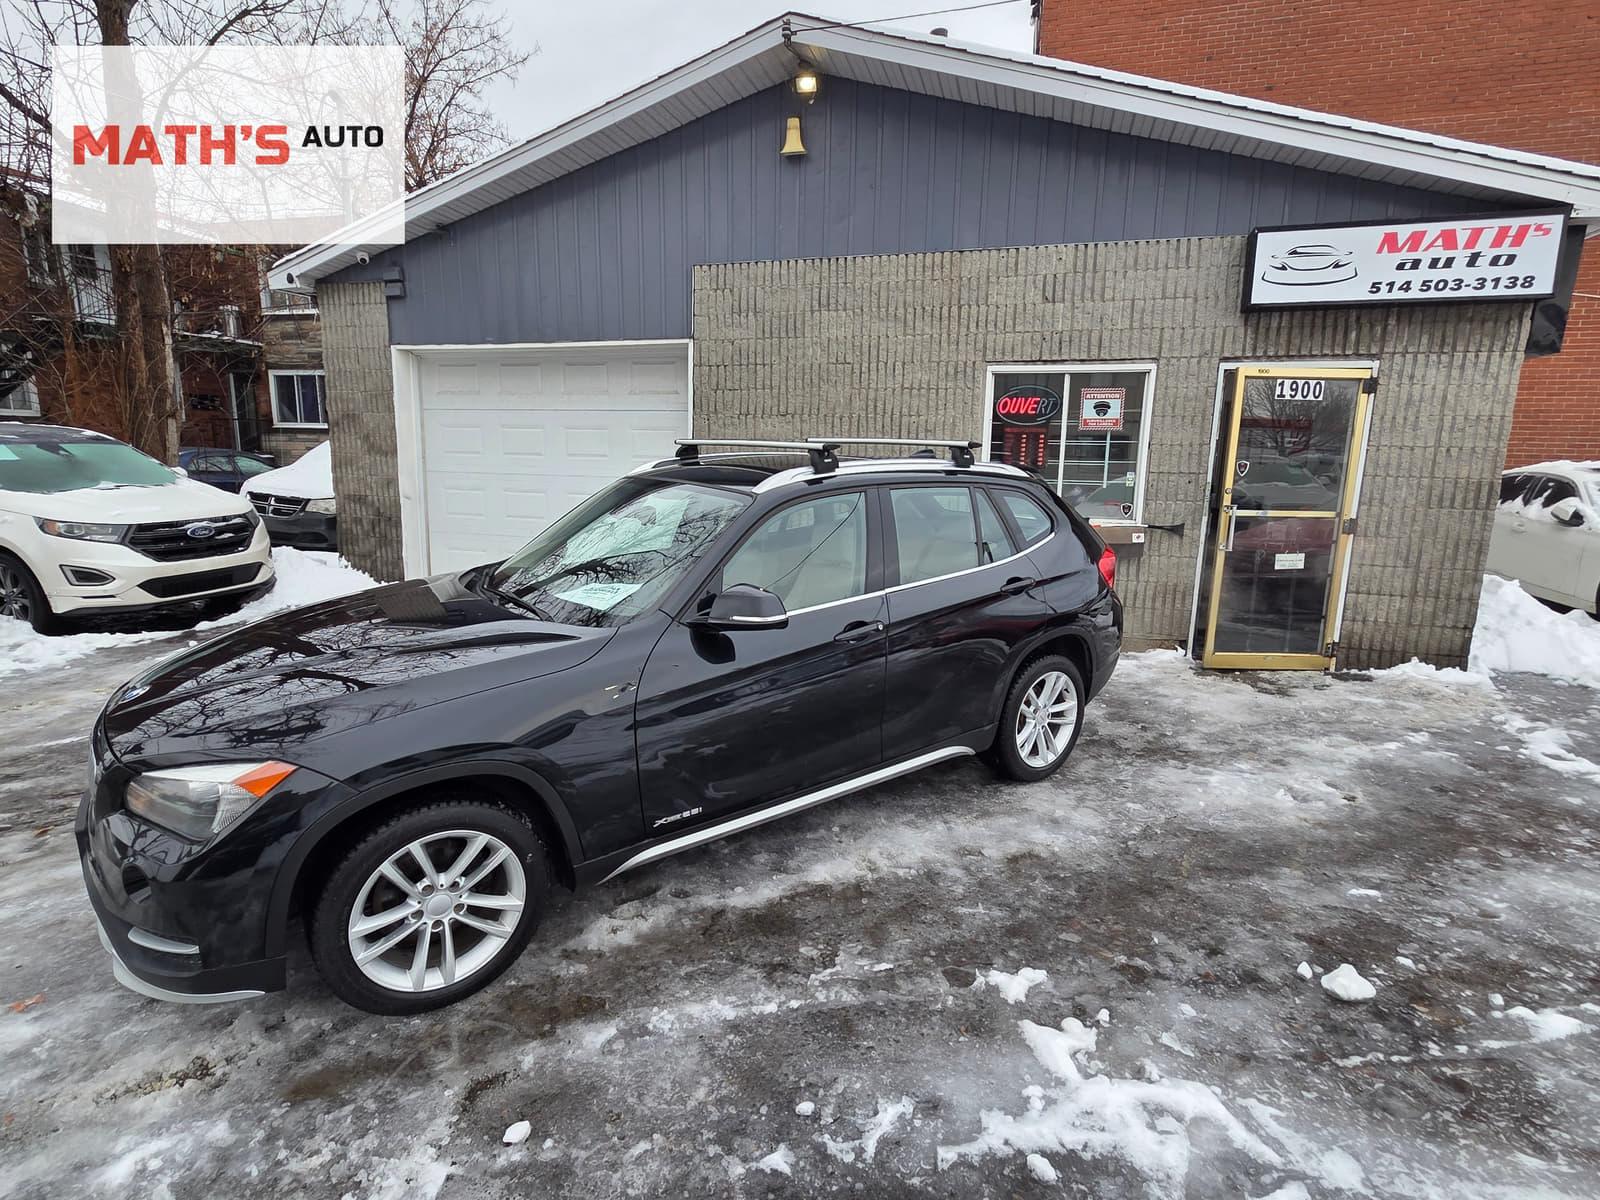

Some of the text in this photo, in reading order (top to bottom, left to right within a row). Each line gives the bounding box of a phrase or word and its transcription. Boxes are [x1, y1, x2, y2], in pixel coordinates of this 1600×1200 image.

[1395, 251, 1518, 271] auto
[1368, 275, 1536, 295] 514 503-3138
[1276, 380, 1323, 399] 1900
[998, 397, 1057, 414] OUVERT
